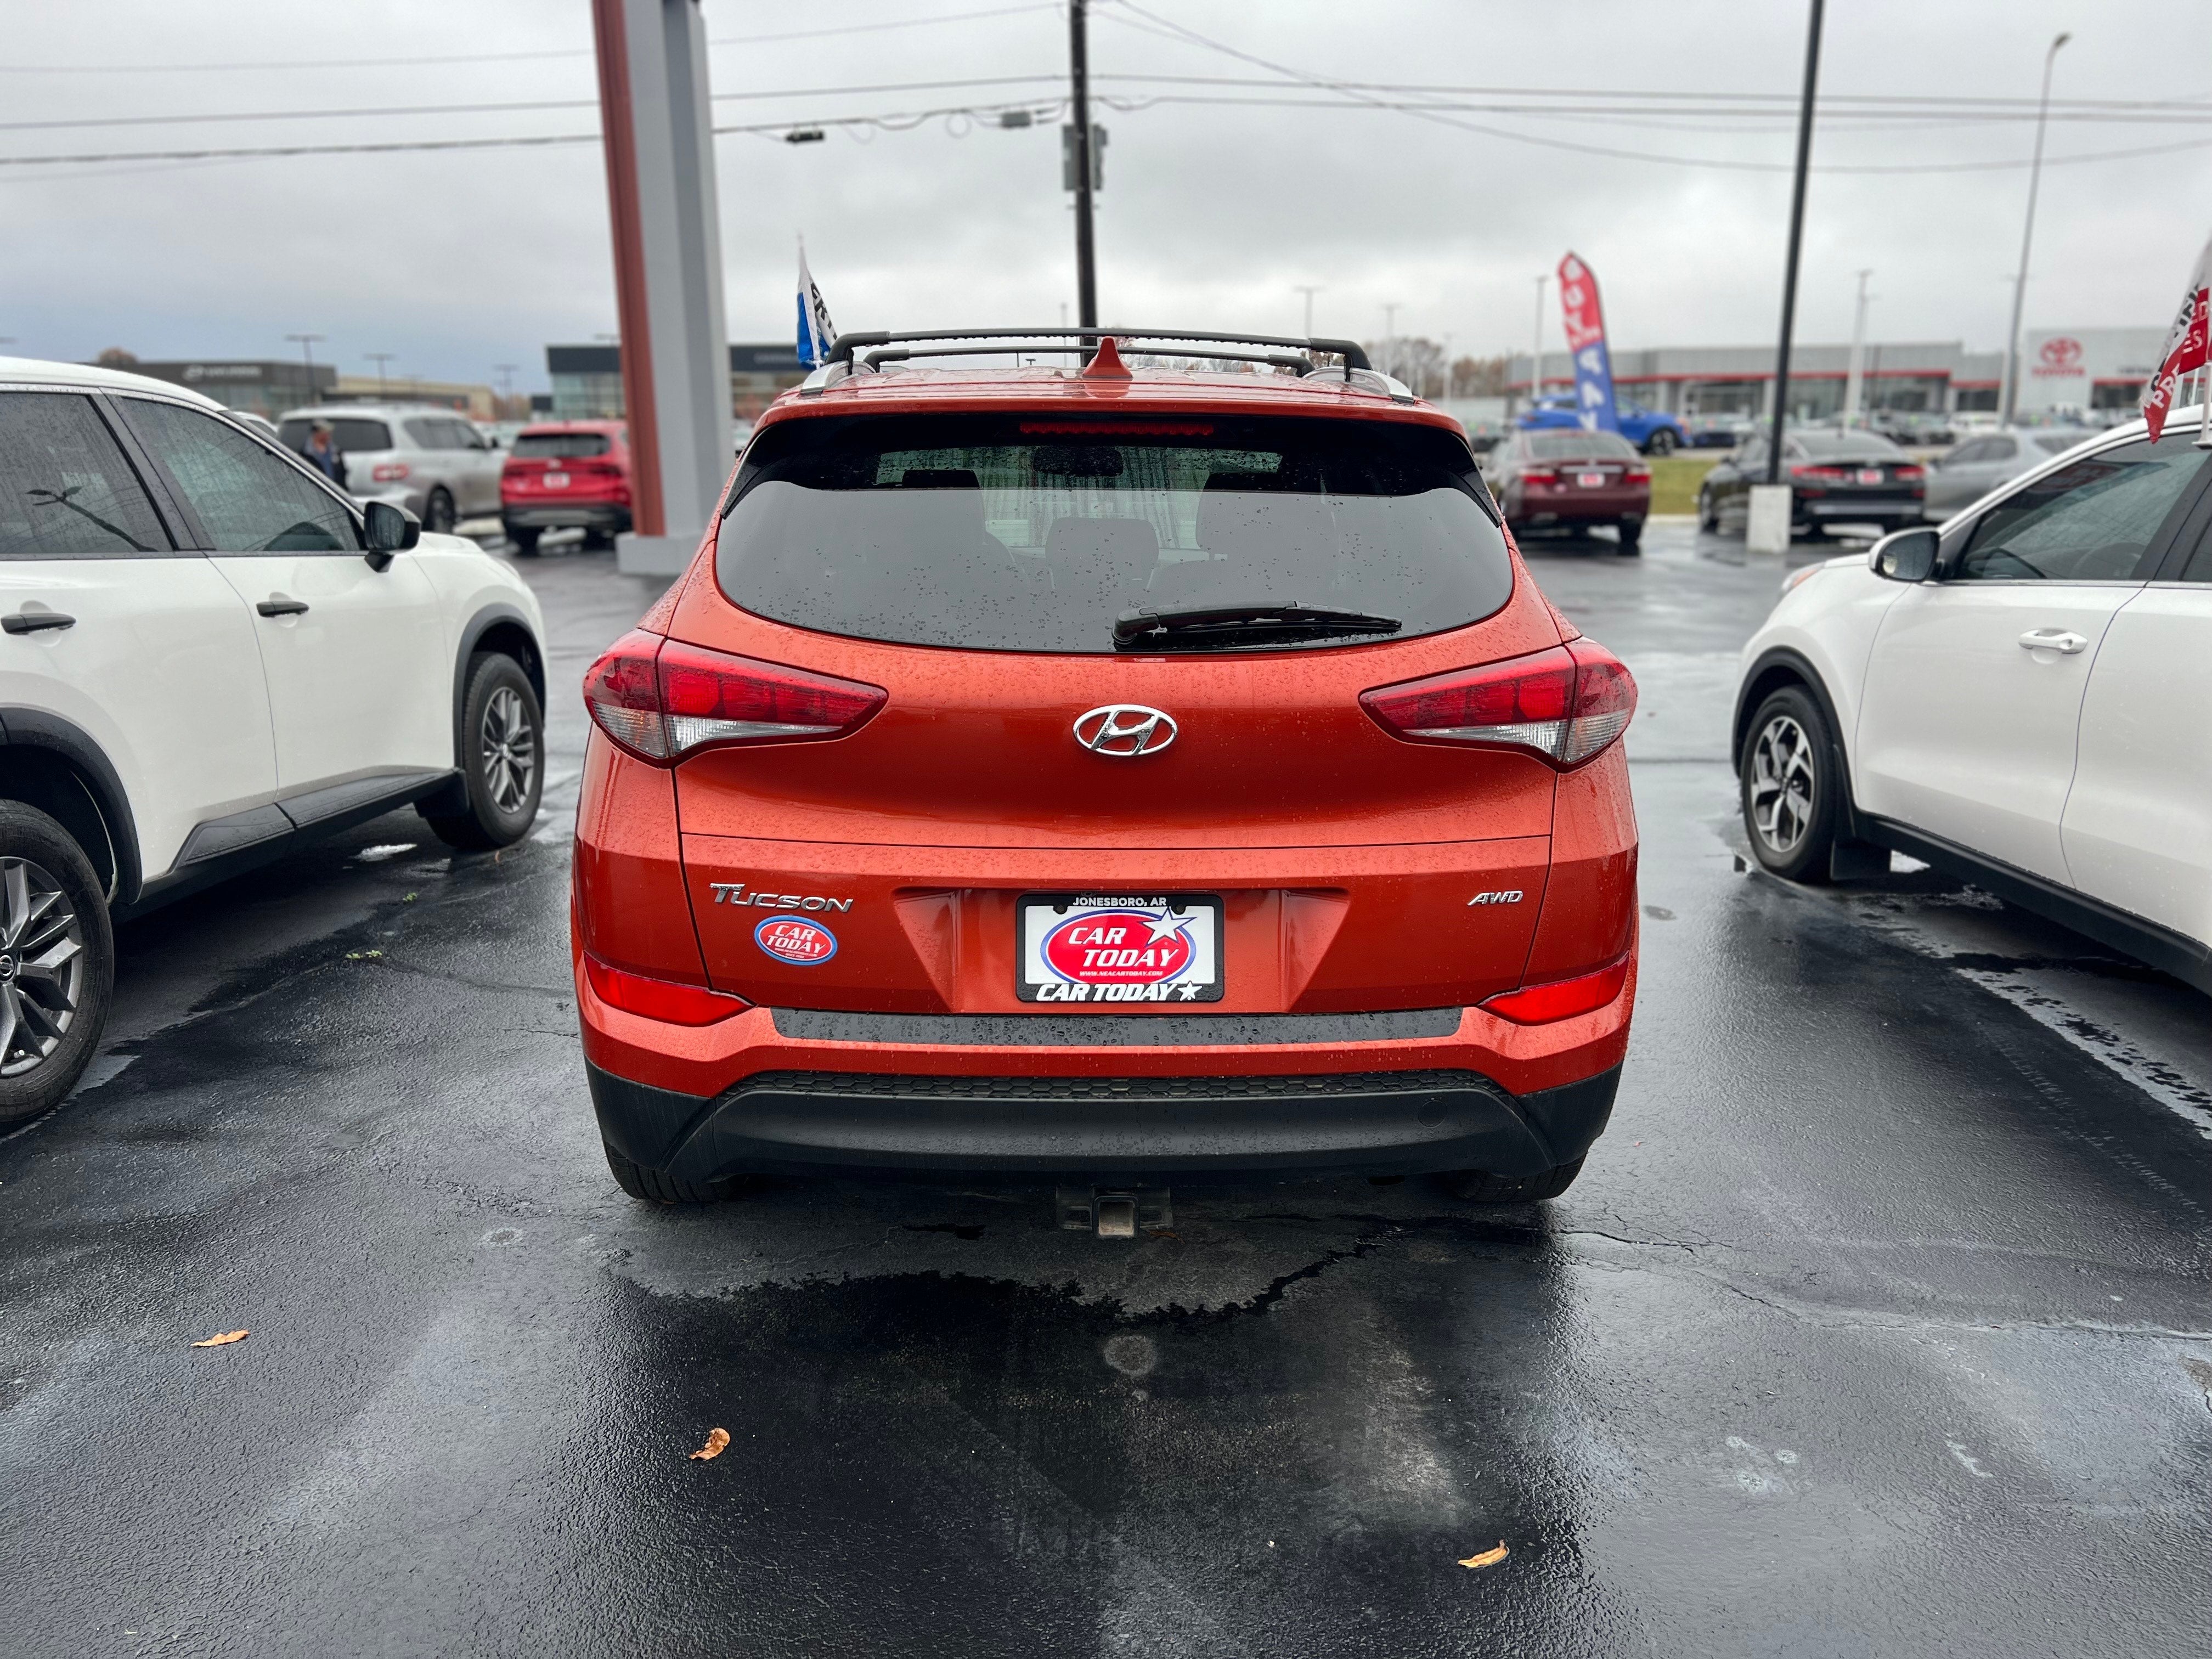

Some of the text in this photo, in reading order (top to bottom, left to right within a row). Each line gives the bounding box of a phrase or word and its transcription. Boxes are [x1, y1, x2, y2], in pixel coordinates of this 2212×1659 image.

[1073, 897, 1167, 907] JONESBORO, AR
[1467, 890, 1523, 906] AWD
[775, 924, 817, 941] CAR
[1068, 927, 1127, 945] CAR
[766, 935, 826, 954] TODAY
[1082, 949, 1179, 967] TODAY
[1036, 983, 1178, 1001] CAR TODAY
